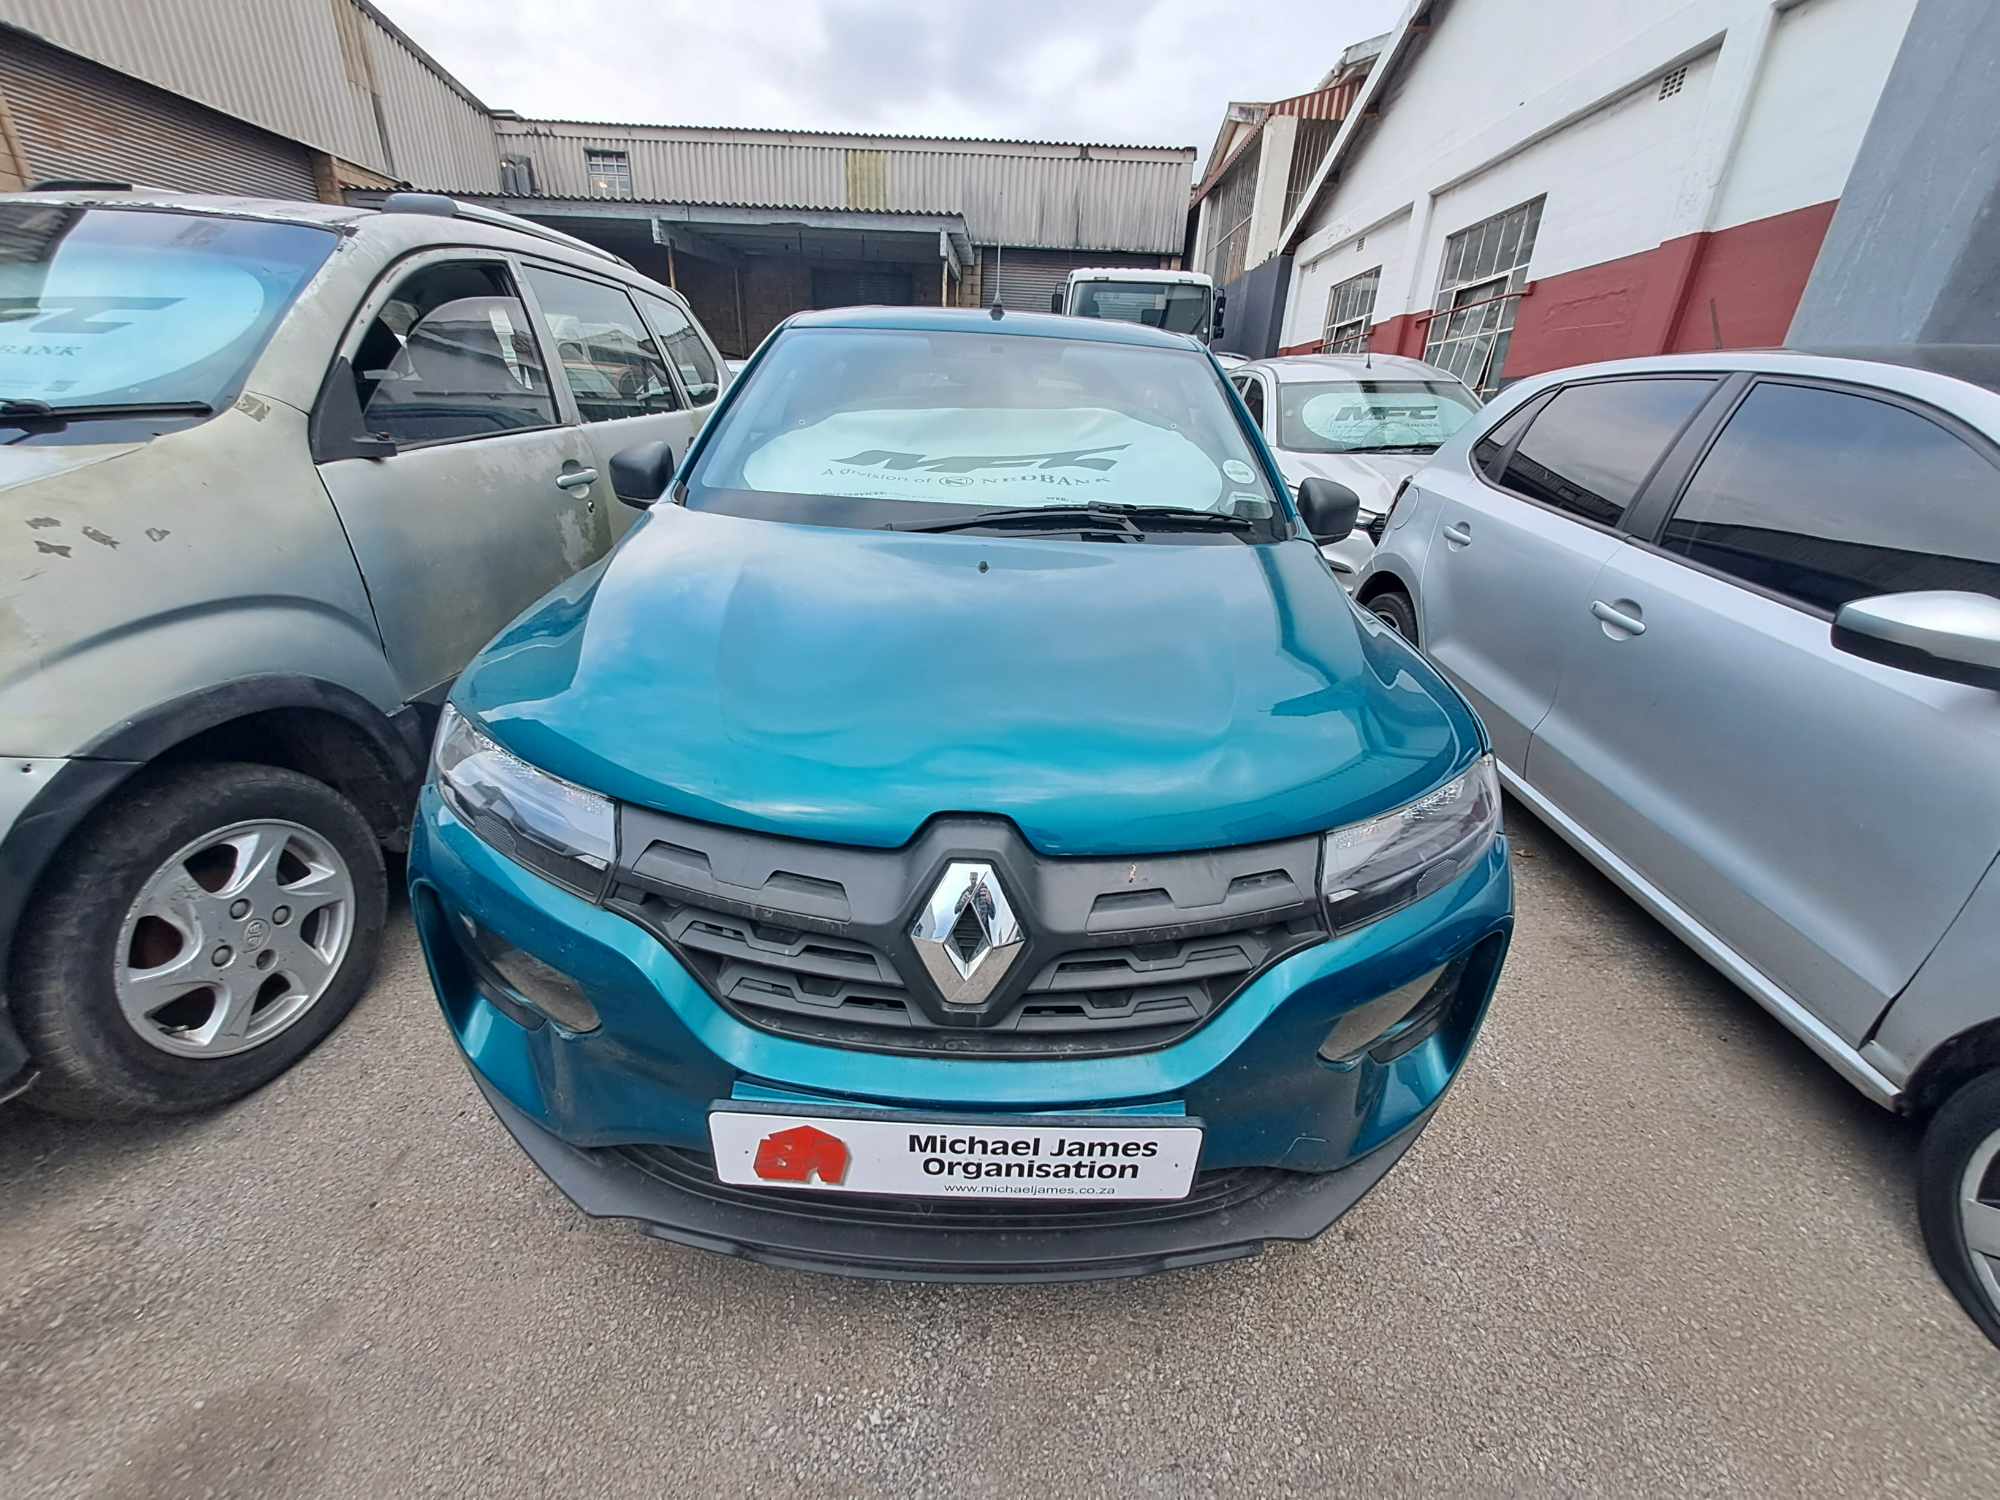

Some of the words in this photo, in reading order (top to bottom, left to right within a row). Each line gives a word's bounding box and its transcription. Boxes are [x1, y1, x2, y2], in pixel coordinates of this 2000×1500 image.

[1335, 406, 1438, 421] MFC
[908, 1134, 1041, 1156] Michael
[1050, 1138, 1159, 1157] James
[922, 1157, 1140, 1180] Organisation
[943, 1184, 1116, 1196] www.michaeljames.co.za
